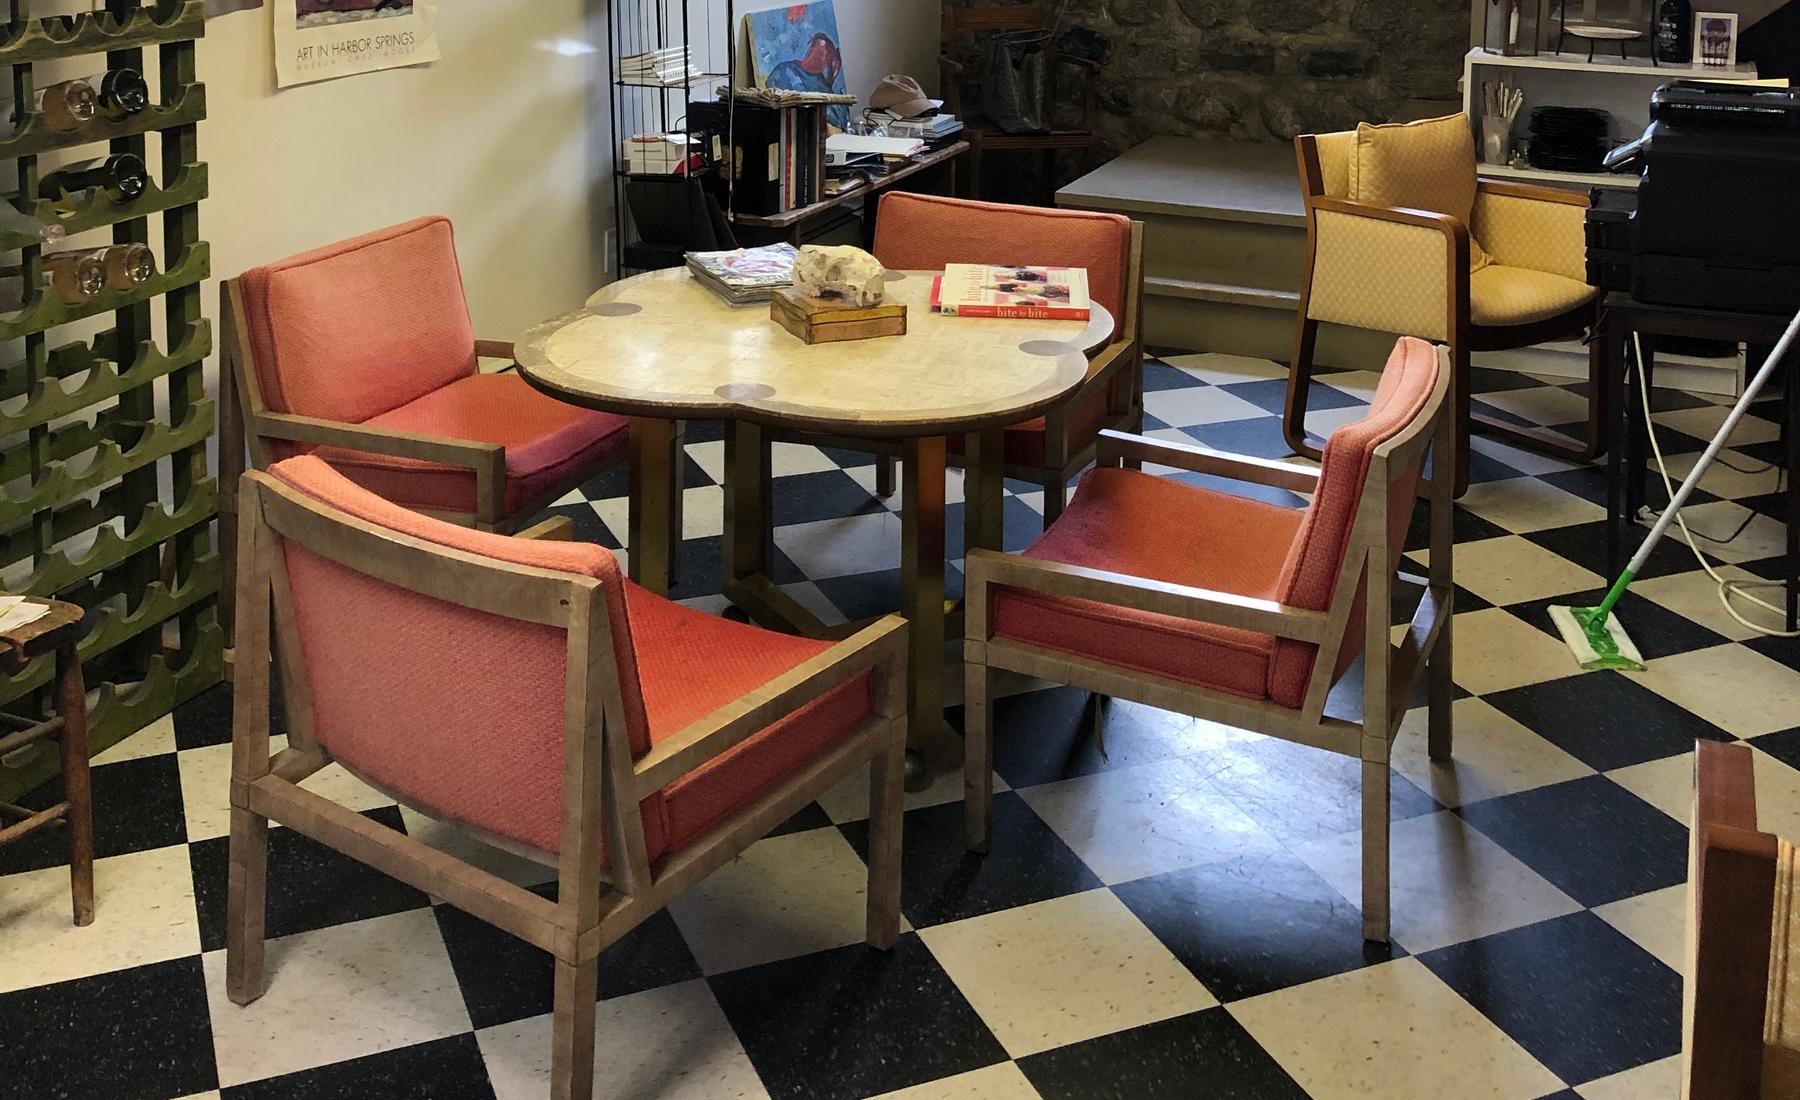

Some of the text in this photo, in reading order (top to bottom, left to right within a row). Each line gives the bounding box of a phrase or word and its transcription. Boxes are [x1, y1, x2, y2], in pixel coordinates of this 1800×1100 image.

[296, 31, 415, 62] ART IN HARBOR SPRINGS
[996, 306, 1018, 318] bite
[1027, 307, 1049, 319] bite
